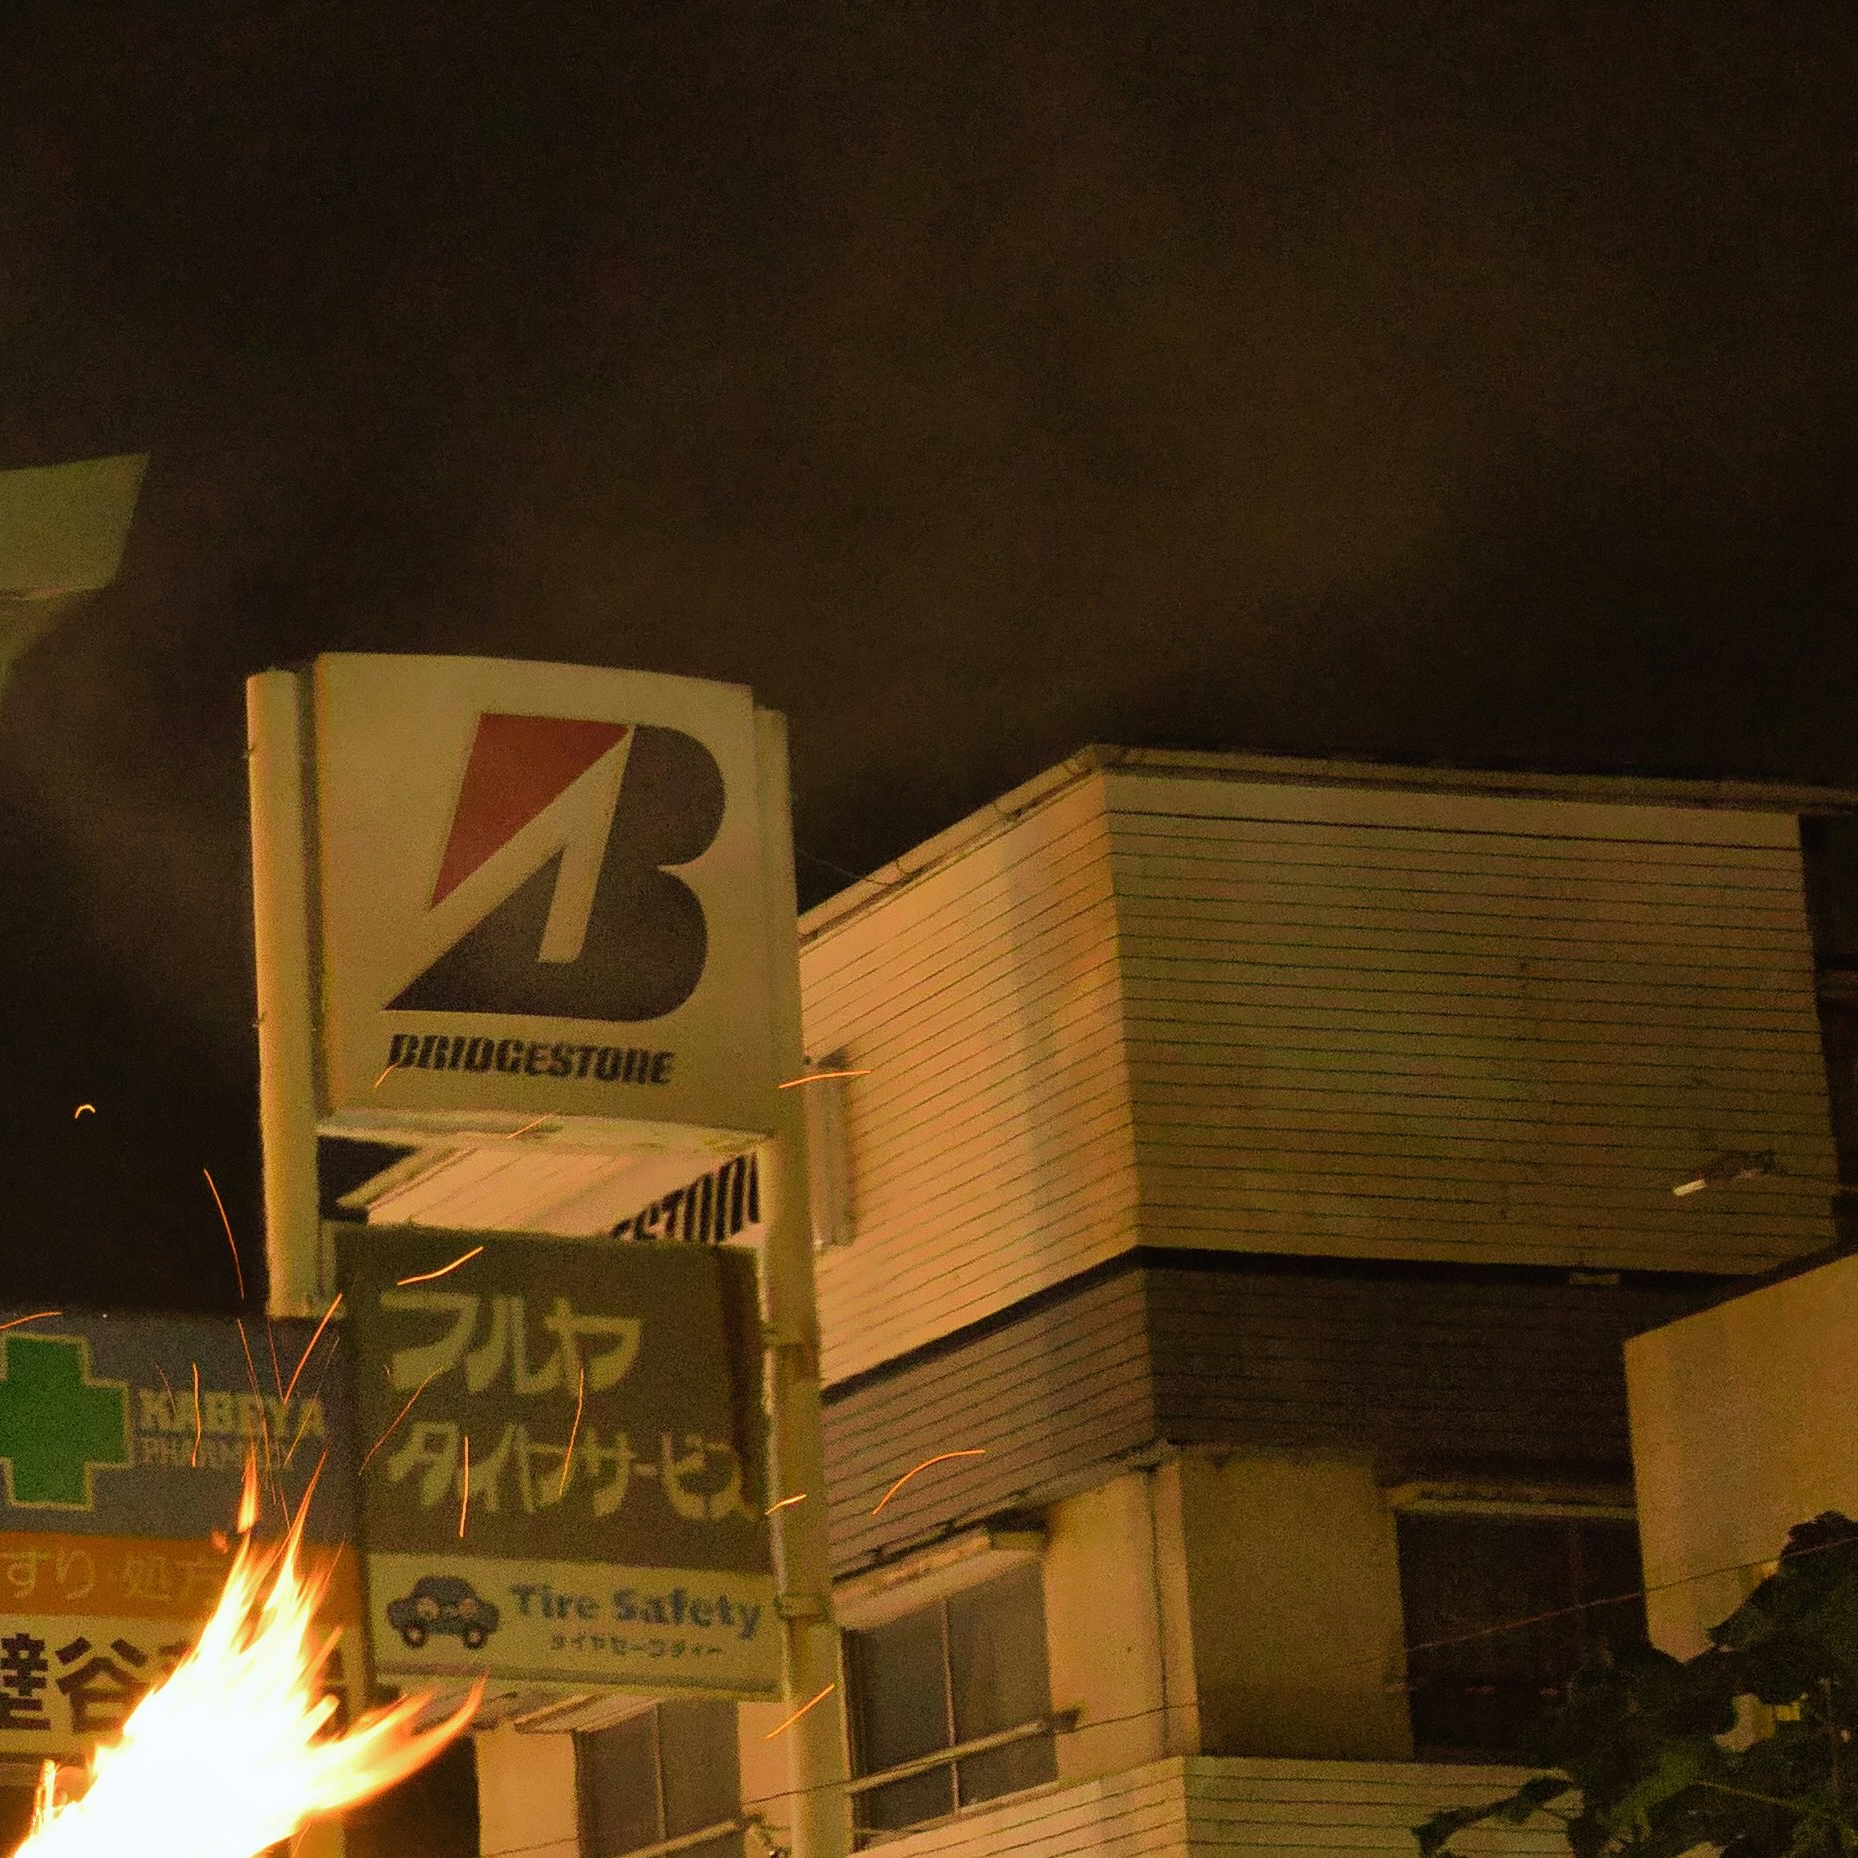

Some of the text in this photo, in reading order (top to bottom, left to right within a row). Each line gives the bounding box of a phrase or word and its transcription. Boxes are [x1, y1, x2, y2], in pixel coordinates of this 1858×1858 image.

[388, 1034, 676, 1085] BRIDGESTONE
[381, 1293, 644, 1396] フルヤ
[138, 1388, 326, 1438] KABEYA
[387, 1421, 760, 1521] タイヤサービス
[511, 1583, 761, 1642] Tire Safety
